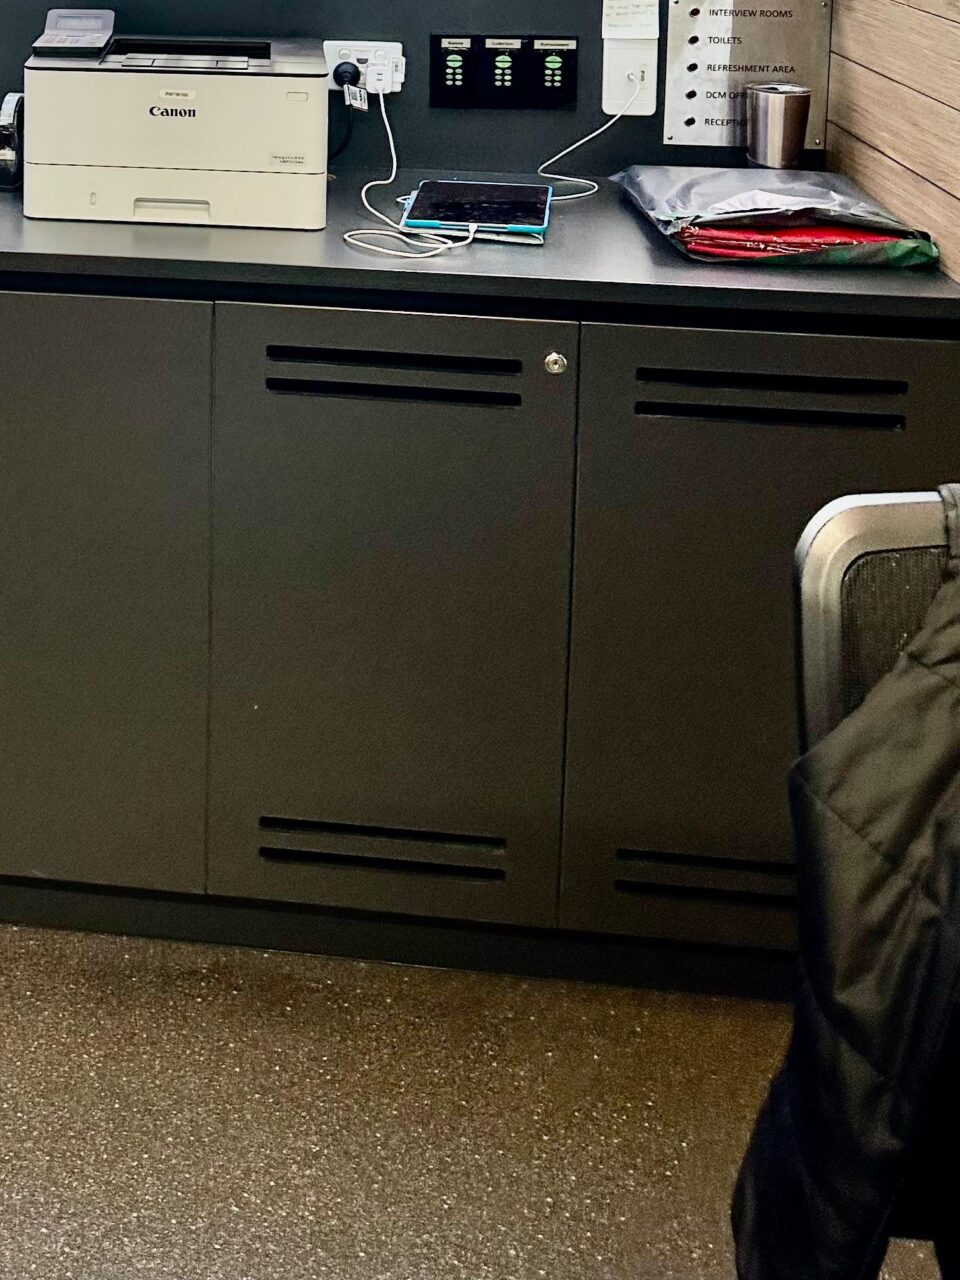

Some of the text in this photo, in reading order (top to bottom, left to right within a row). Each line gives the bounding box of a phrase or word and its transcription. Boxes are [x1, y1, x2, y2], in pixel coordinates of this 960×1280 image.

[708, 8, 794, 19] INTERVIEW ROOMS
[707, 36, 743, 45] TOILETS
[706, 64, 796, 74] REFRESHMENT AREA
[705, 91, 748, 100] DCM OFF
[148, 105, 196, 118] Canon
